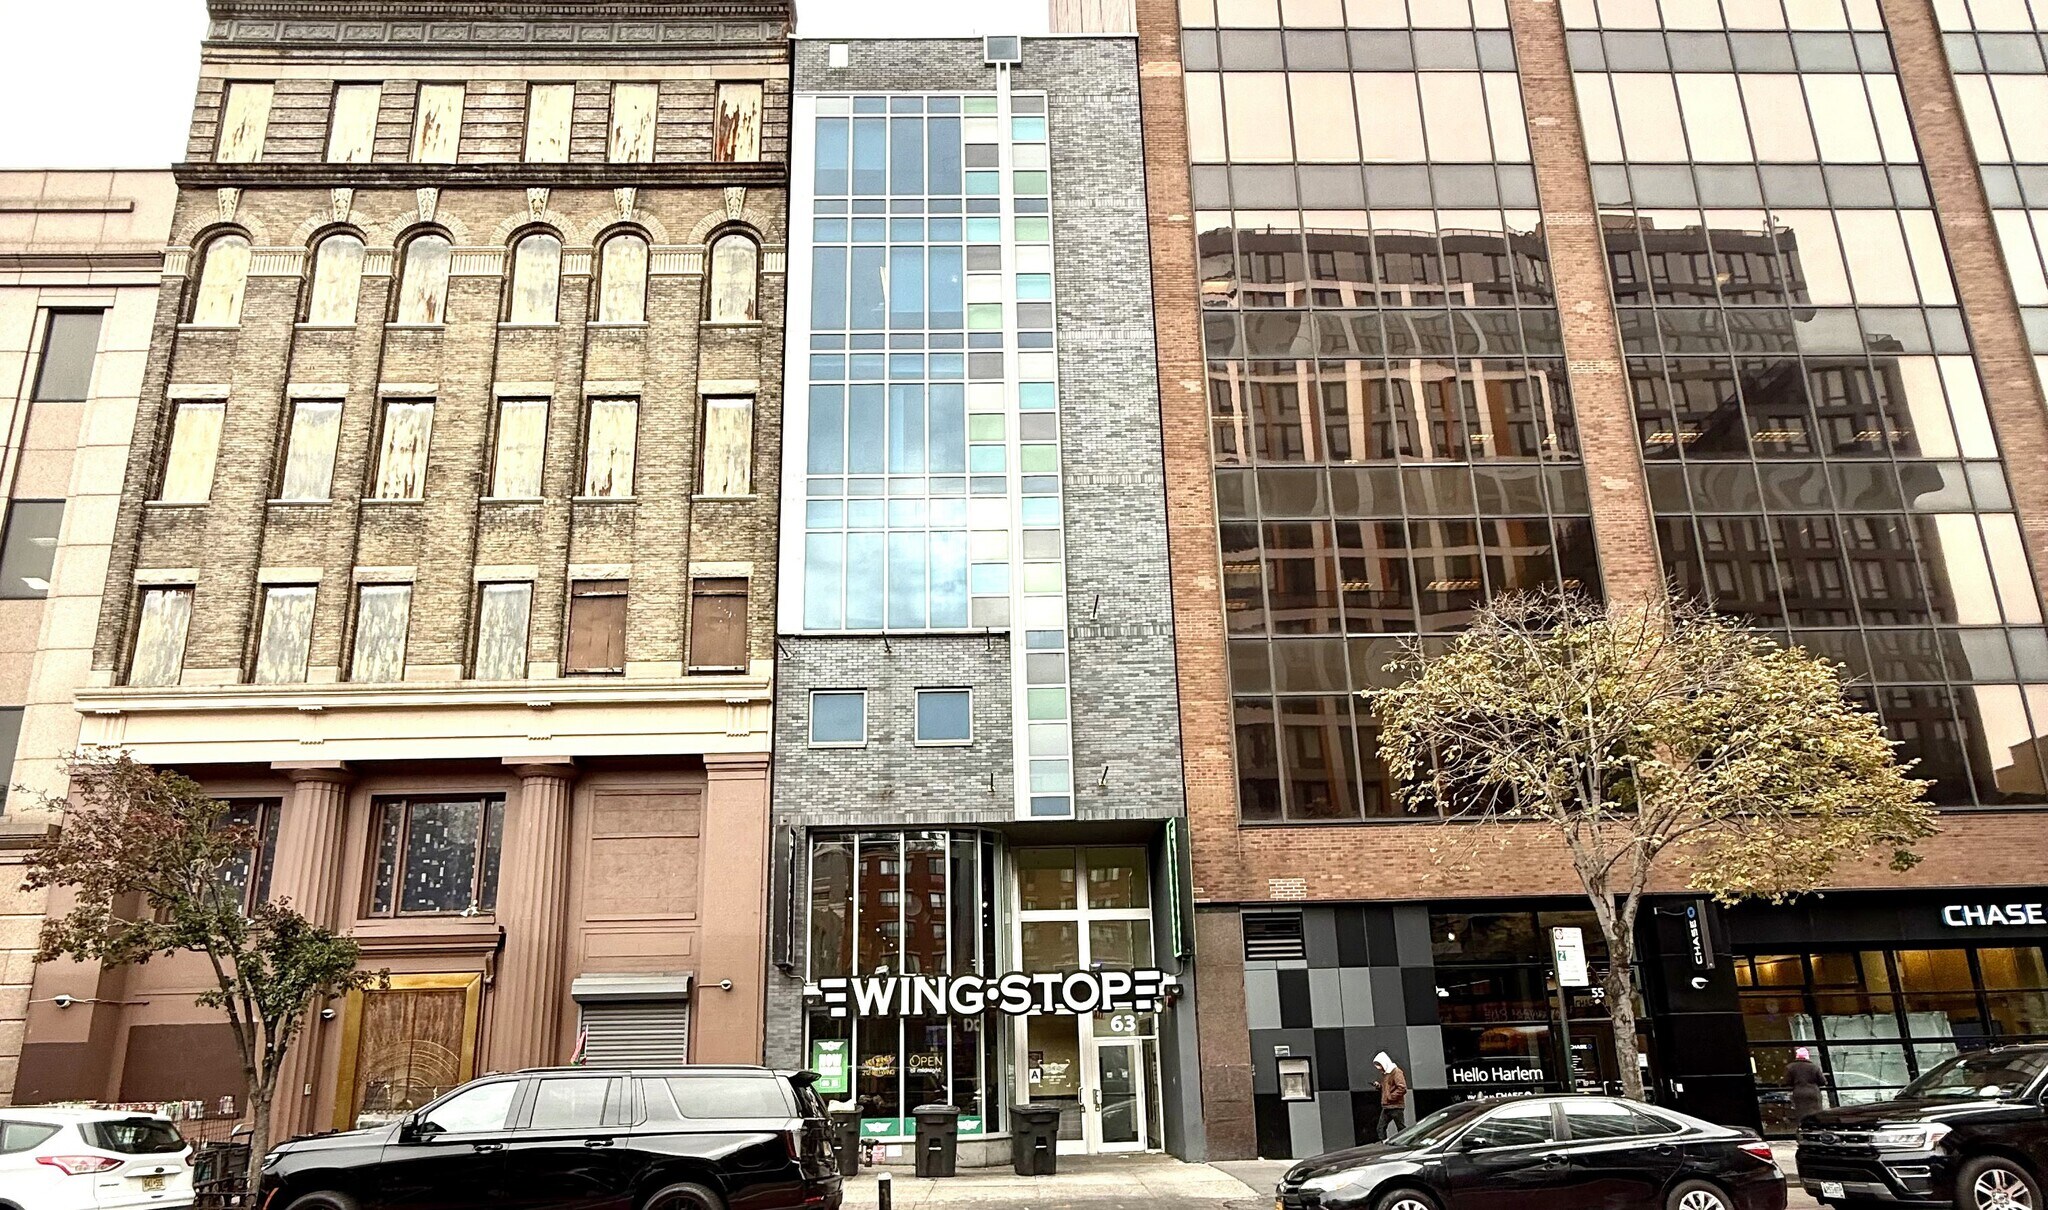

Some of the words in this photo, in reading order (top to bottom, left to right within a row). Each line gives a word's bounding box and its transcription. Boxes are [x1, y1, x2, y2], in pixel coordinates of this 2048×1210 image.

[1942, 903, 2047, 927] CHASE
[1689, 919, 1703, 965] CHASE
[1591, 987, 1605, 998] 55
[1110, 1015, 1137, 1032] 63
[909, 1054, 943, 1067] OPEN
[1031, 1070, 1039, 1079] A
[1452, 1067, 1489, 1082] Hello
[1491, 1066, 1544, 1081] Harlem
